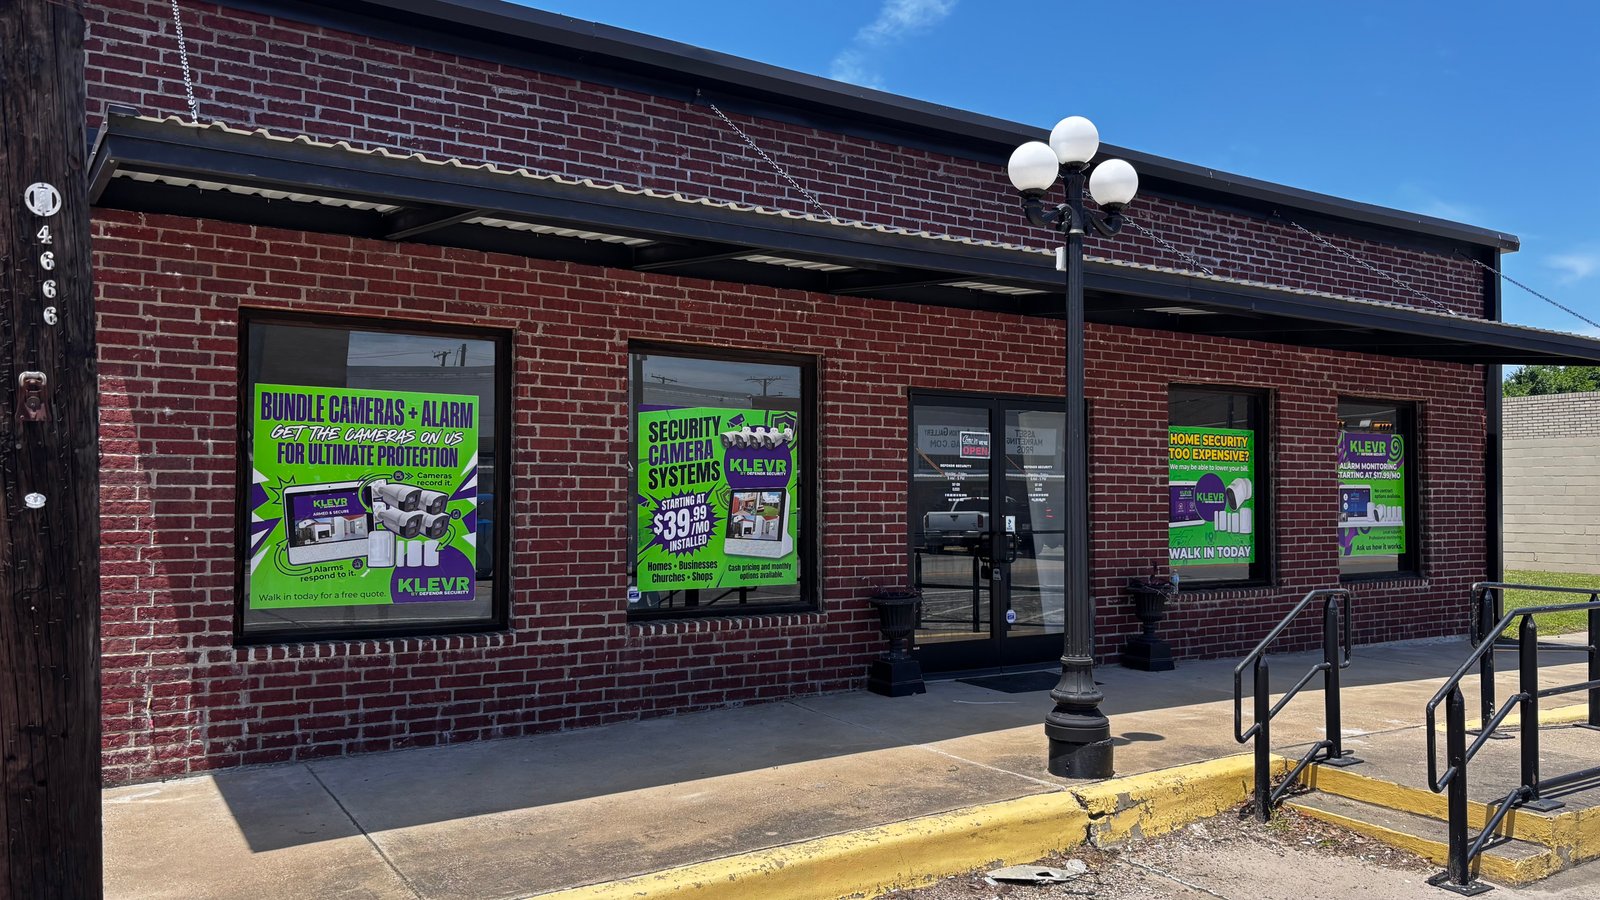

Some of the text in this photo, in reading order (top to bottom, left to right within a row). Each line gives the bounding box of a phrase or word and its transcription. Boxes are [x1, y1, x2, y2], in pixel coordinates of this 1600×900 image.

[37, 225, 57, 325] 4666
[261, 392, 473, 428] BUNDLE CAMERAS + ALARM
[270, 424, 463, 445] GET THE CAMERAS ON US
[648, 416, 721, 443] SECURITY
[1169, 433, 1248, 448] HOME SECURITY
[1350, 440, 1386, 453] KLEVR
[277, 442, 458, 468] FOR ULTIMATE PROTECTION
[648, 439, 714, 466] CAMERA
[963, 445, 988, 456] OPEN
[1168, 447, 1250, 462] TOO EXPENSIVE?
[729, 458, 786, 472] KLEVR
[1340, 462, 1397, 470] ALARM MONITORING
[648, 460, 721, 490] SYSTEMS
[313, 497, 348, 508] KLEVR
[661, 493, 706, 511] STARTING AT
[1196, 493, 1224, 501] KLEVR
[669, 534, 707, 552] INSTALLED
[1169, 546, 1251, 559] WALK IN TODAY
[314, 565, 344, 573] Alarms
[647, 560, 718, 571] Homes Businesses
[742, 563, 760, 571] pricing
[771, 562, 791, 570] monthly
[300, 572, 335, 583] respond
[652, 571, 713, 583] Churches Shops
[740, 572, 759, 580] options
[398, 577, 470, 593] KLEVR
[259, 593, 281, 601] Walk
[294, 592, 318, 602] today
[360, 591, 386, 599] quote.
